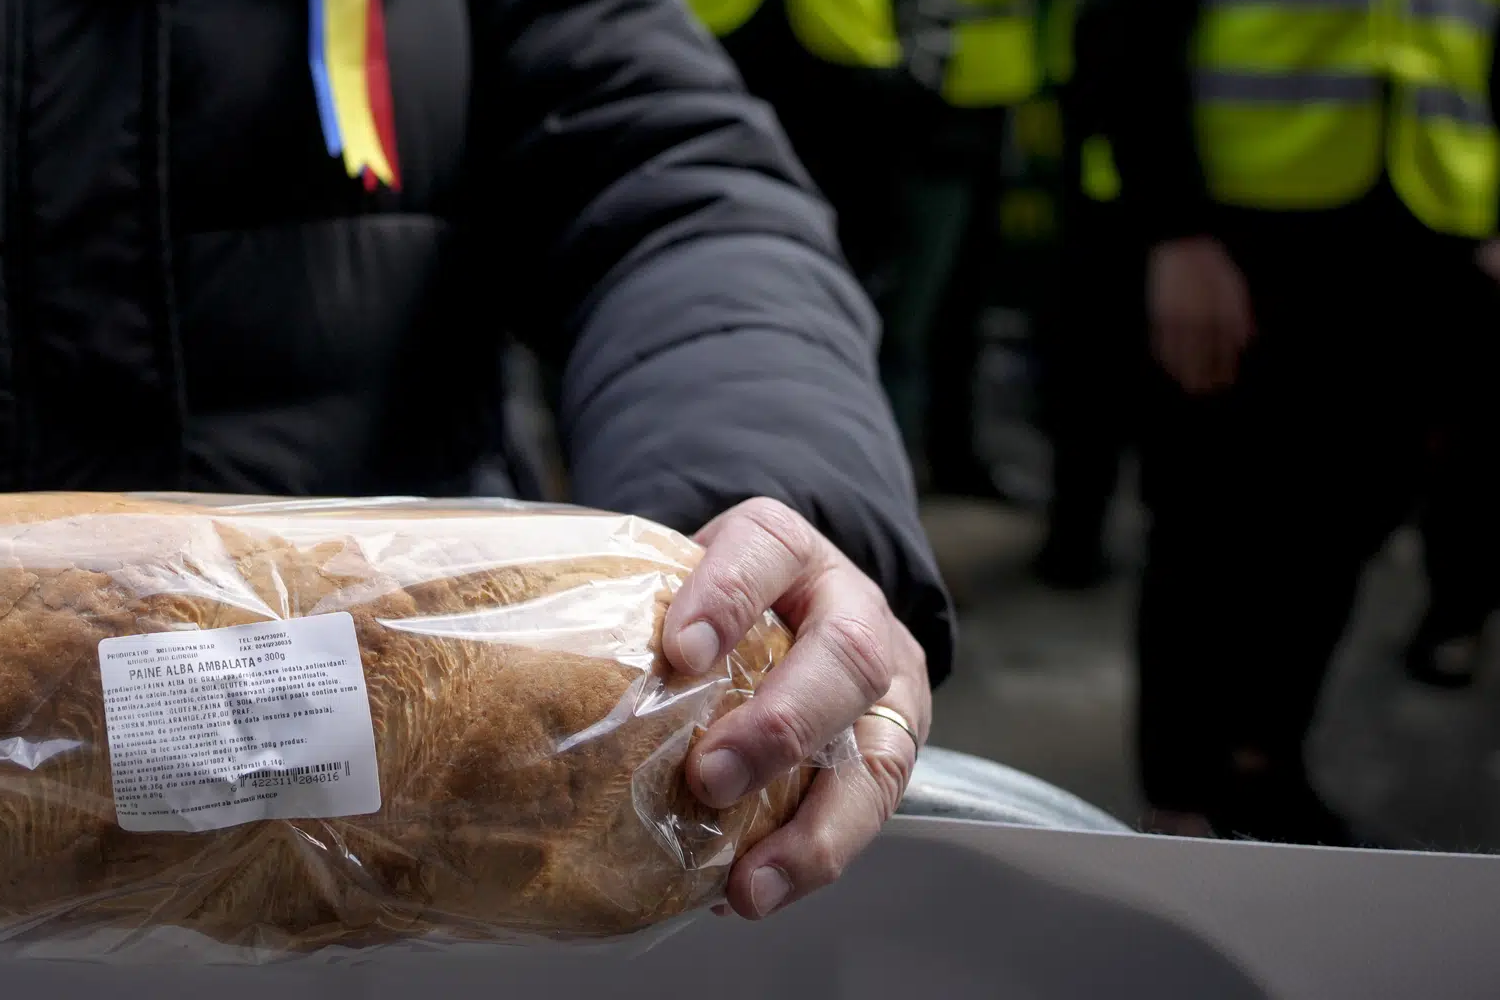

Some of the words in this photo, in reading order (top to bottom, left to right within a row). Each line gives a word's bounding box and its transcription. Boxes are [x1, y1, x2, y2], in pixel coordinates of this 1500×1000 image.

[129, 667, 162, 680] PAINE
[166, 663, 194, 675] ALBA
[198, 658, 256, 672] AMBALATA
[264, 652, 285, 661] 300g
[252, 775, 292, 788] 422311
[299, 772, 340, 784] 204016
